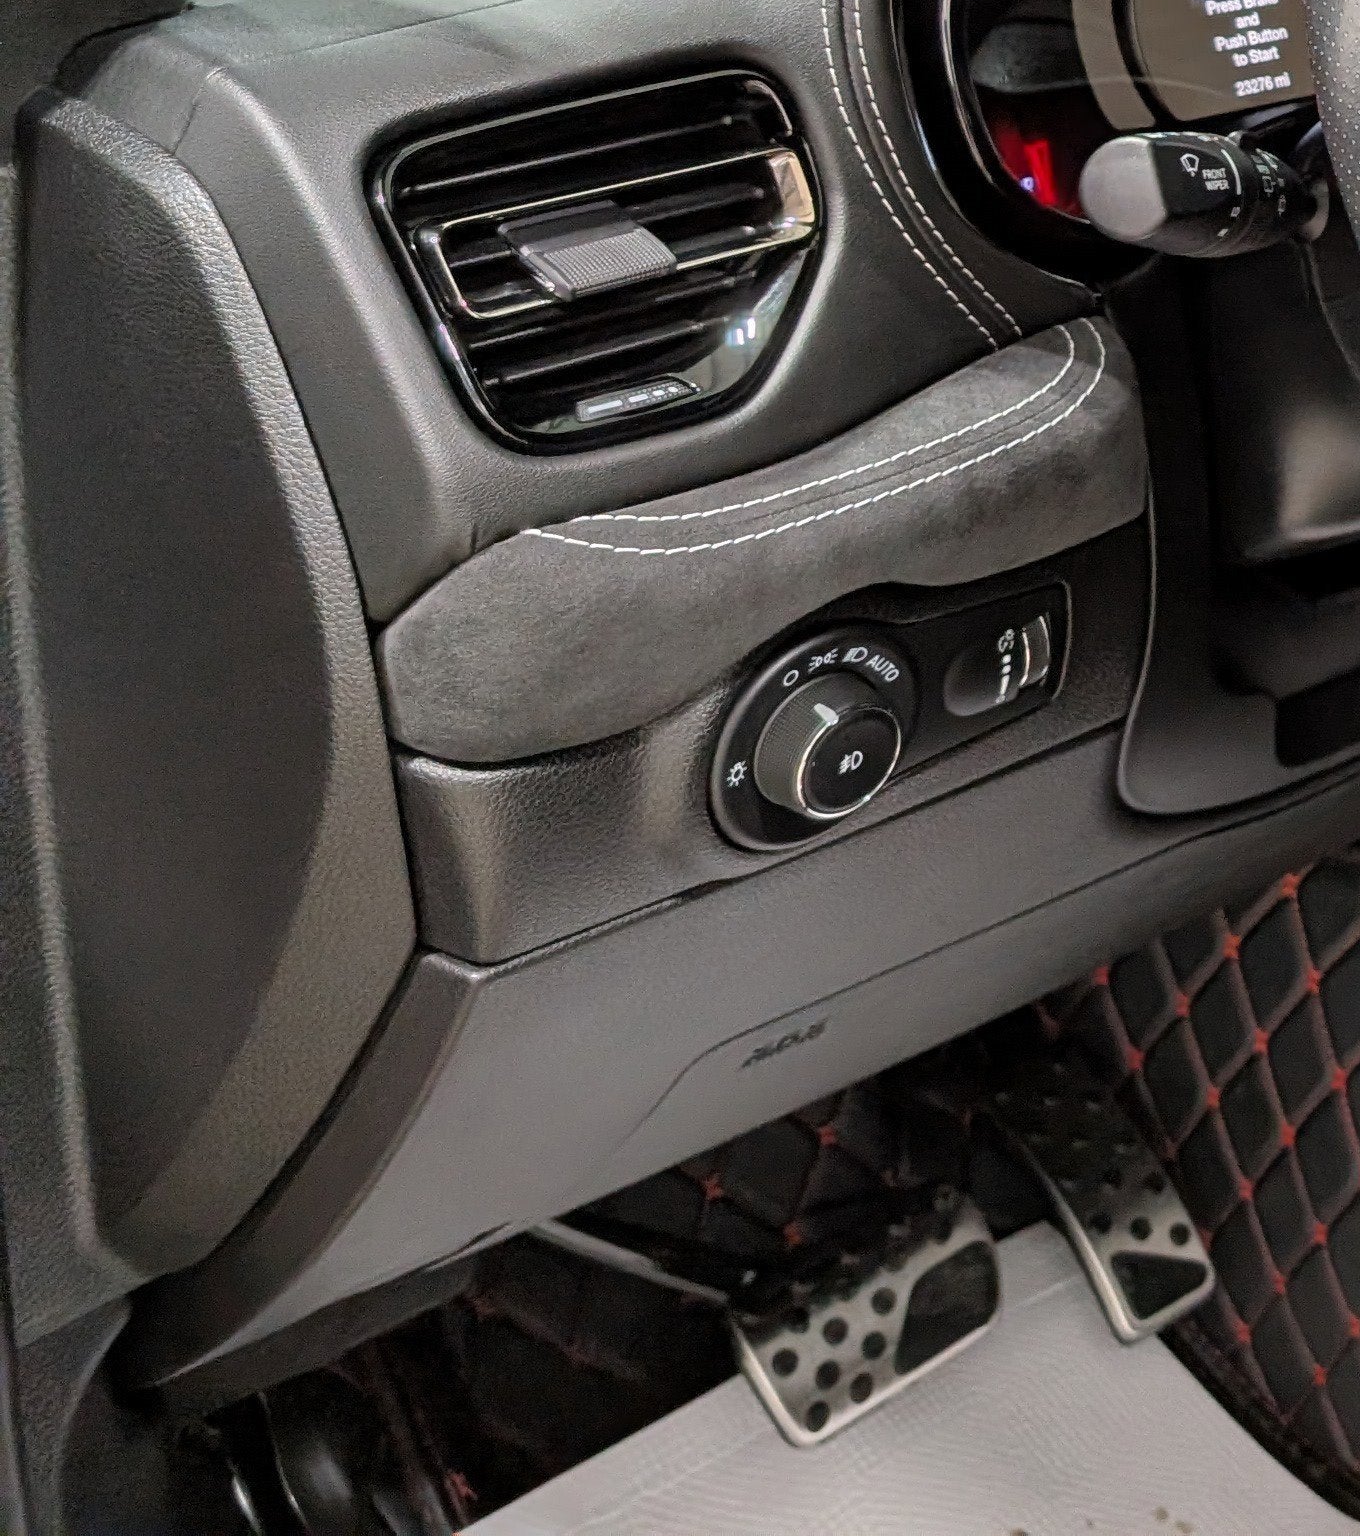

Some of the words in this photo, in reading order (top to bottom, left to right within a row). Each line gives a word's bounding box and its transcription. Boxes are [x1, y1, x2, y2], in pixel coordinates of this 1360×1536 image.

[1234, 12, 1260, 29] and
[1213, 33, 1248, 52] Push
[1247, 27, 1289, 46] Button
[1231, 52, 1248, 67] to
[1248, 46, 1280, 64] Start
[1274, 71, 1291, 88] mi
[1202, 168, 1226, 180] FRONT
[1205, 179, 1230, 192] WIPER
[865, 654, 900, 682] AUTO
